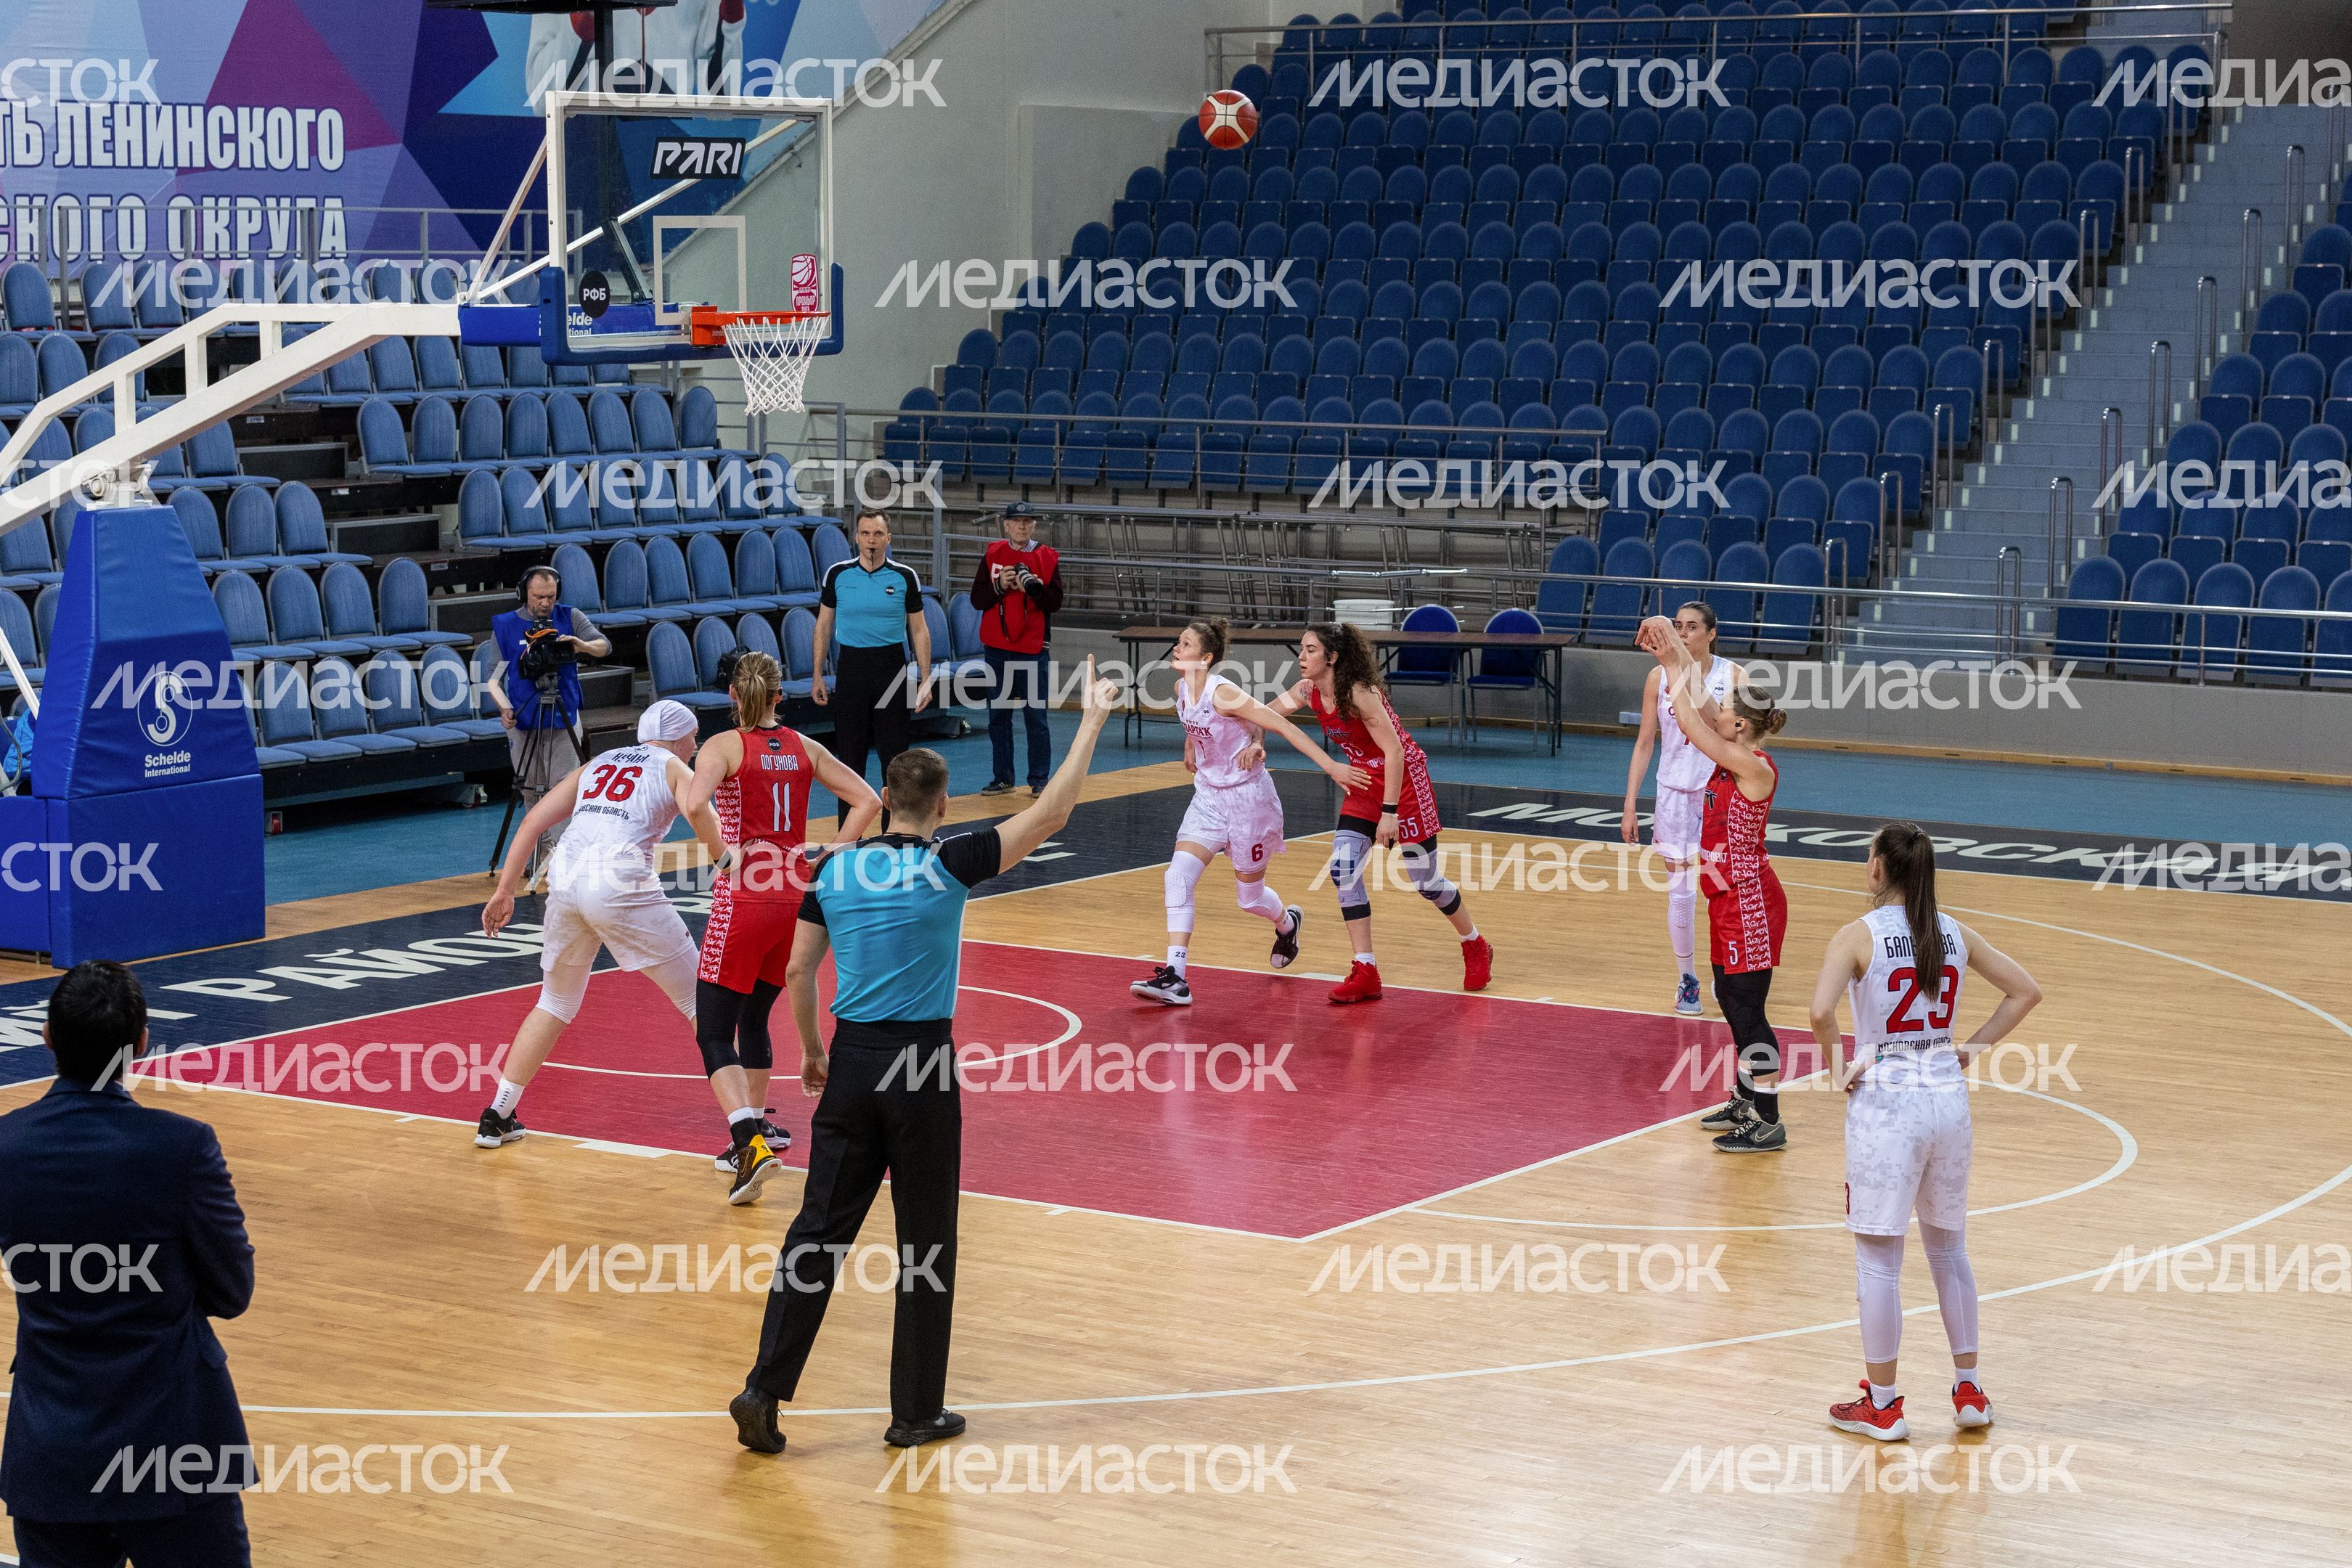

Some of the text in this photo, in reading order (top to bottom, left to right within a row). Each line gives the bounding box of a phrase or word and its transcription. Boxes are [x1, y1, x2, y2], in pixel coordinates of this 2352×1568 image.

[54, 103, 346, 171] ЛЕНИНСКОГО
[653, 142, 742, 174] PARI
[167, 195, 348, 261] ОКРУГА
[583, 288, 606, 301] РФБ
[144, 750, 191, 767] Schelde
[144, 763, 191, 777] International
[760, 754, 799, 771] ПОГУНОВА
[582, 764, 643, 802] 36
[772, 781, 791, 832] 11
[1399, 817, 1419, 839] 55
[1251, 843, 1263, 862] 6
[1728, 941, 1739, 965] 5
[1886, 965, 1959, 1034] 23
